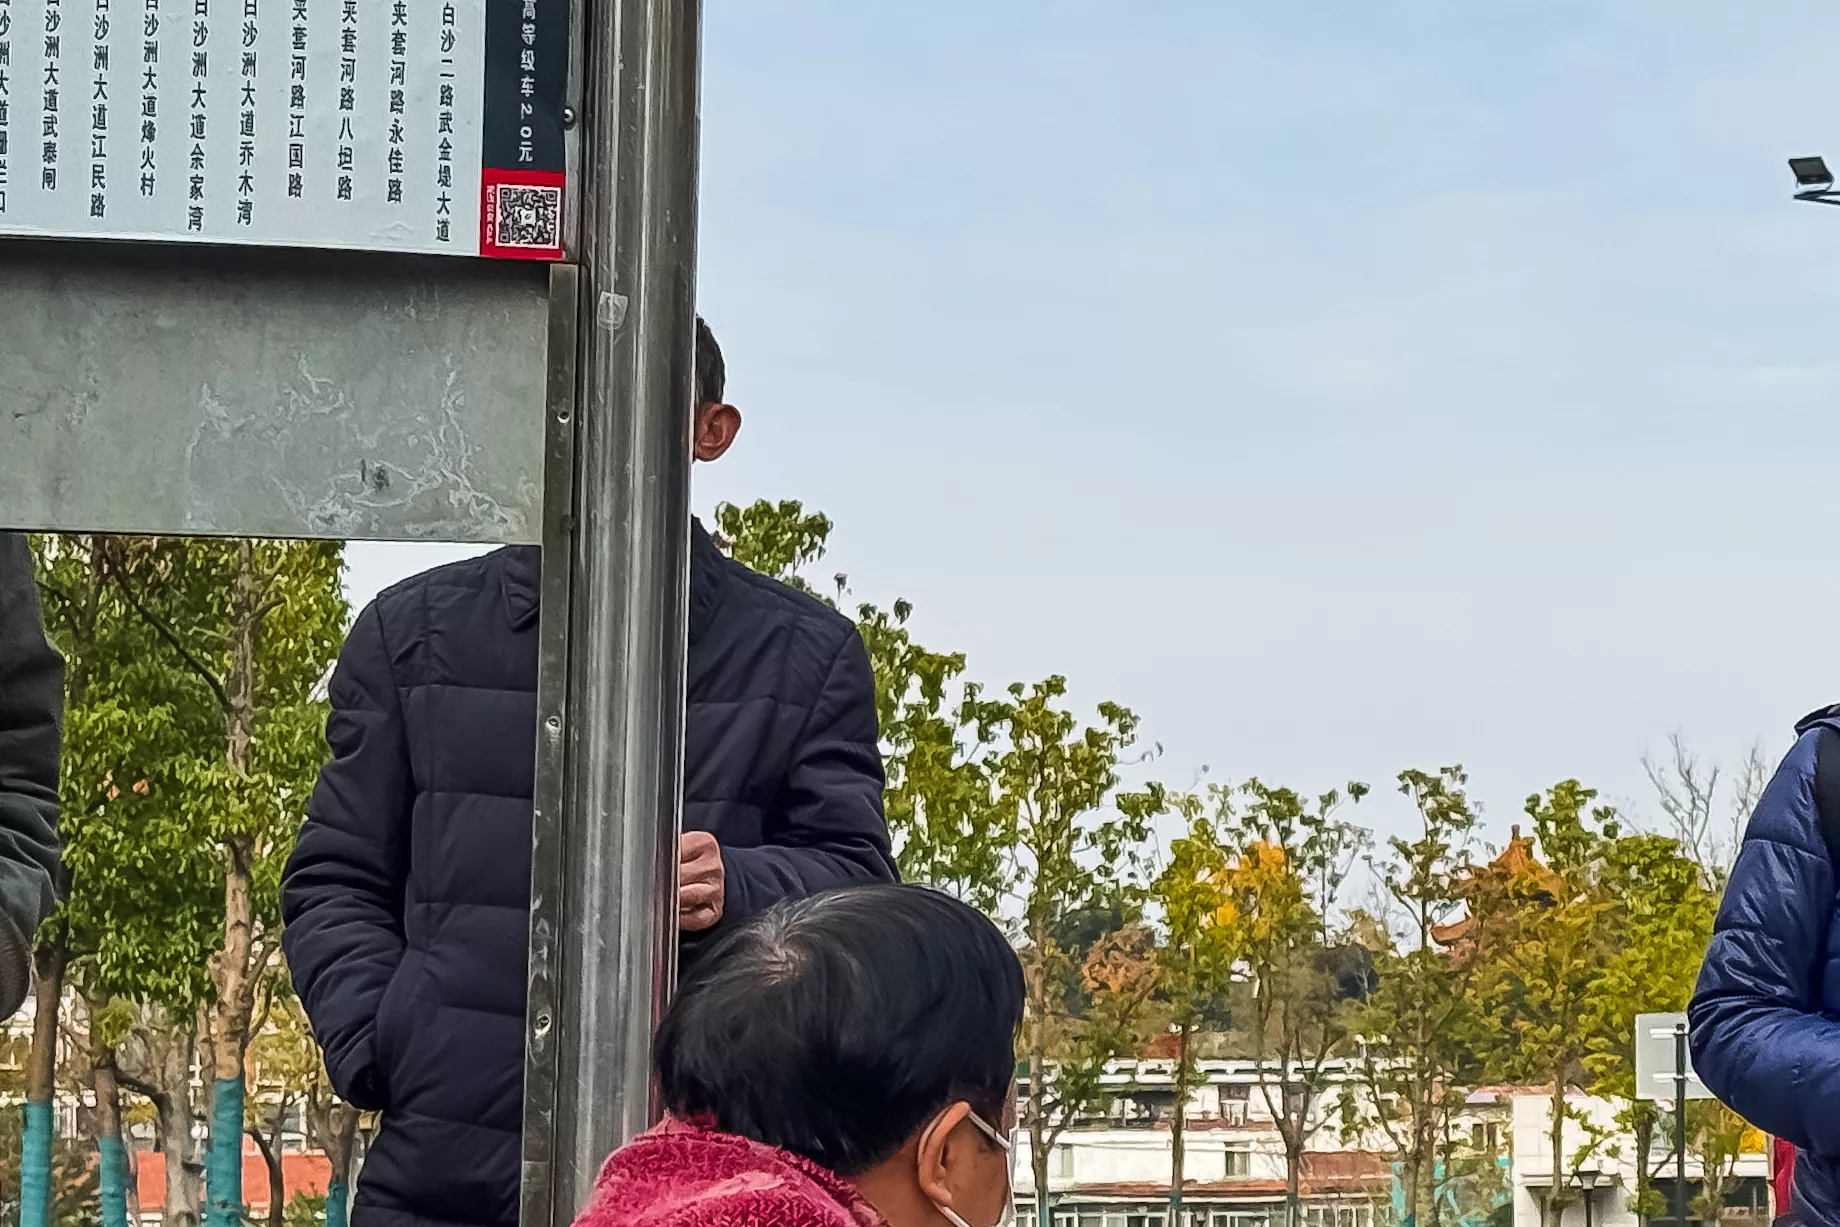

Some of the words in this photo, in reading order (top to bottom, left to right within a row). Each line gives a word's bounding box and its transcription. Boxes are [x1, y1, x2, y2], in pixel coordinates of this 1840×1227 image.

[42, 0, 61, 190] 沙洲大道武泰闸
[387, 1, 407, 203] 夹套河路永佳路
[436, 3, 455, 242] 白沙二路武金堤大道
